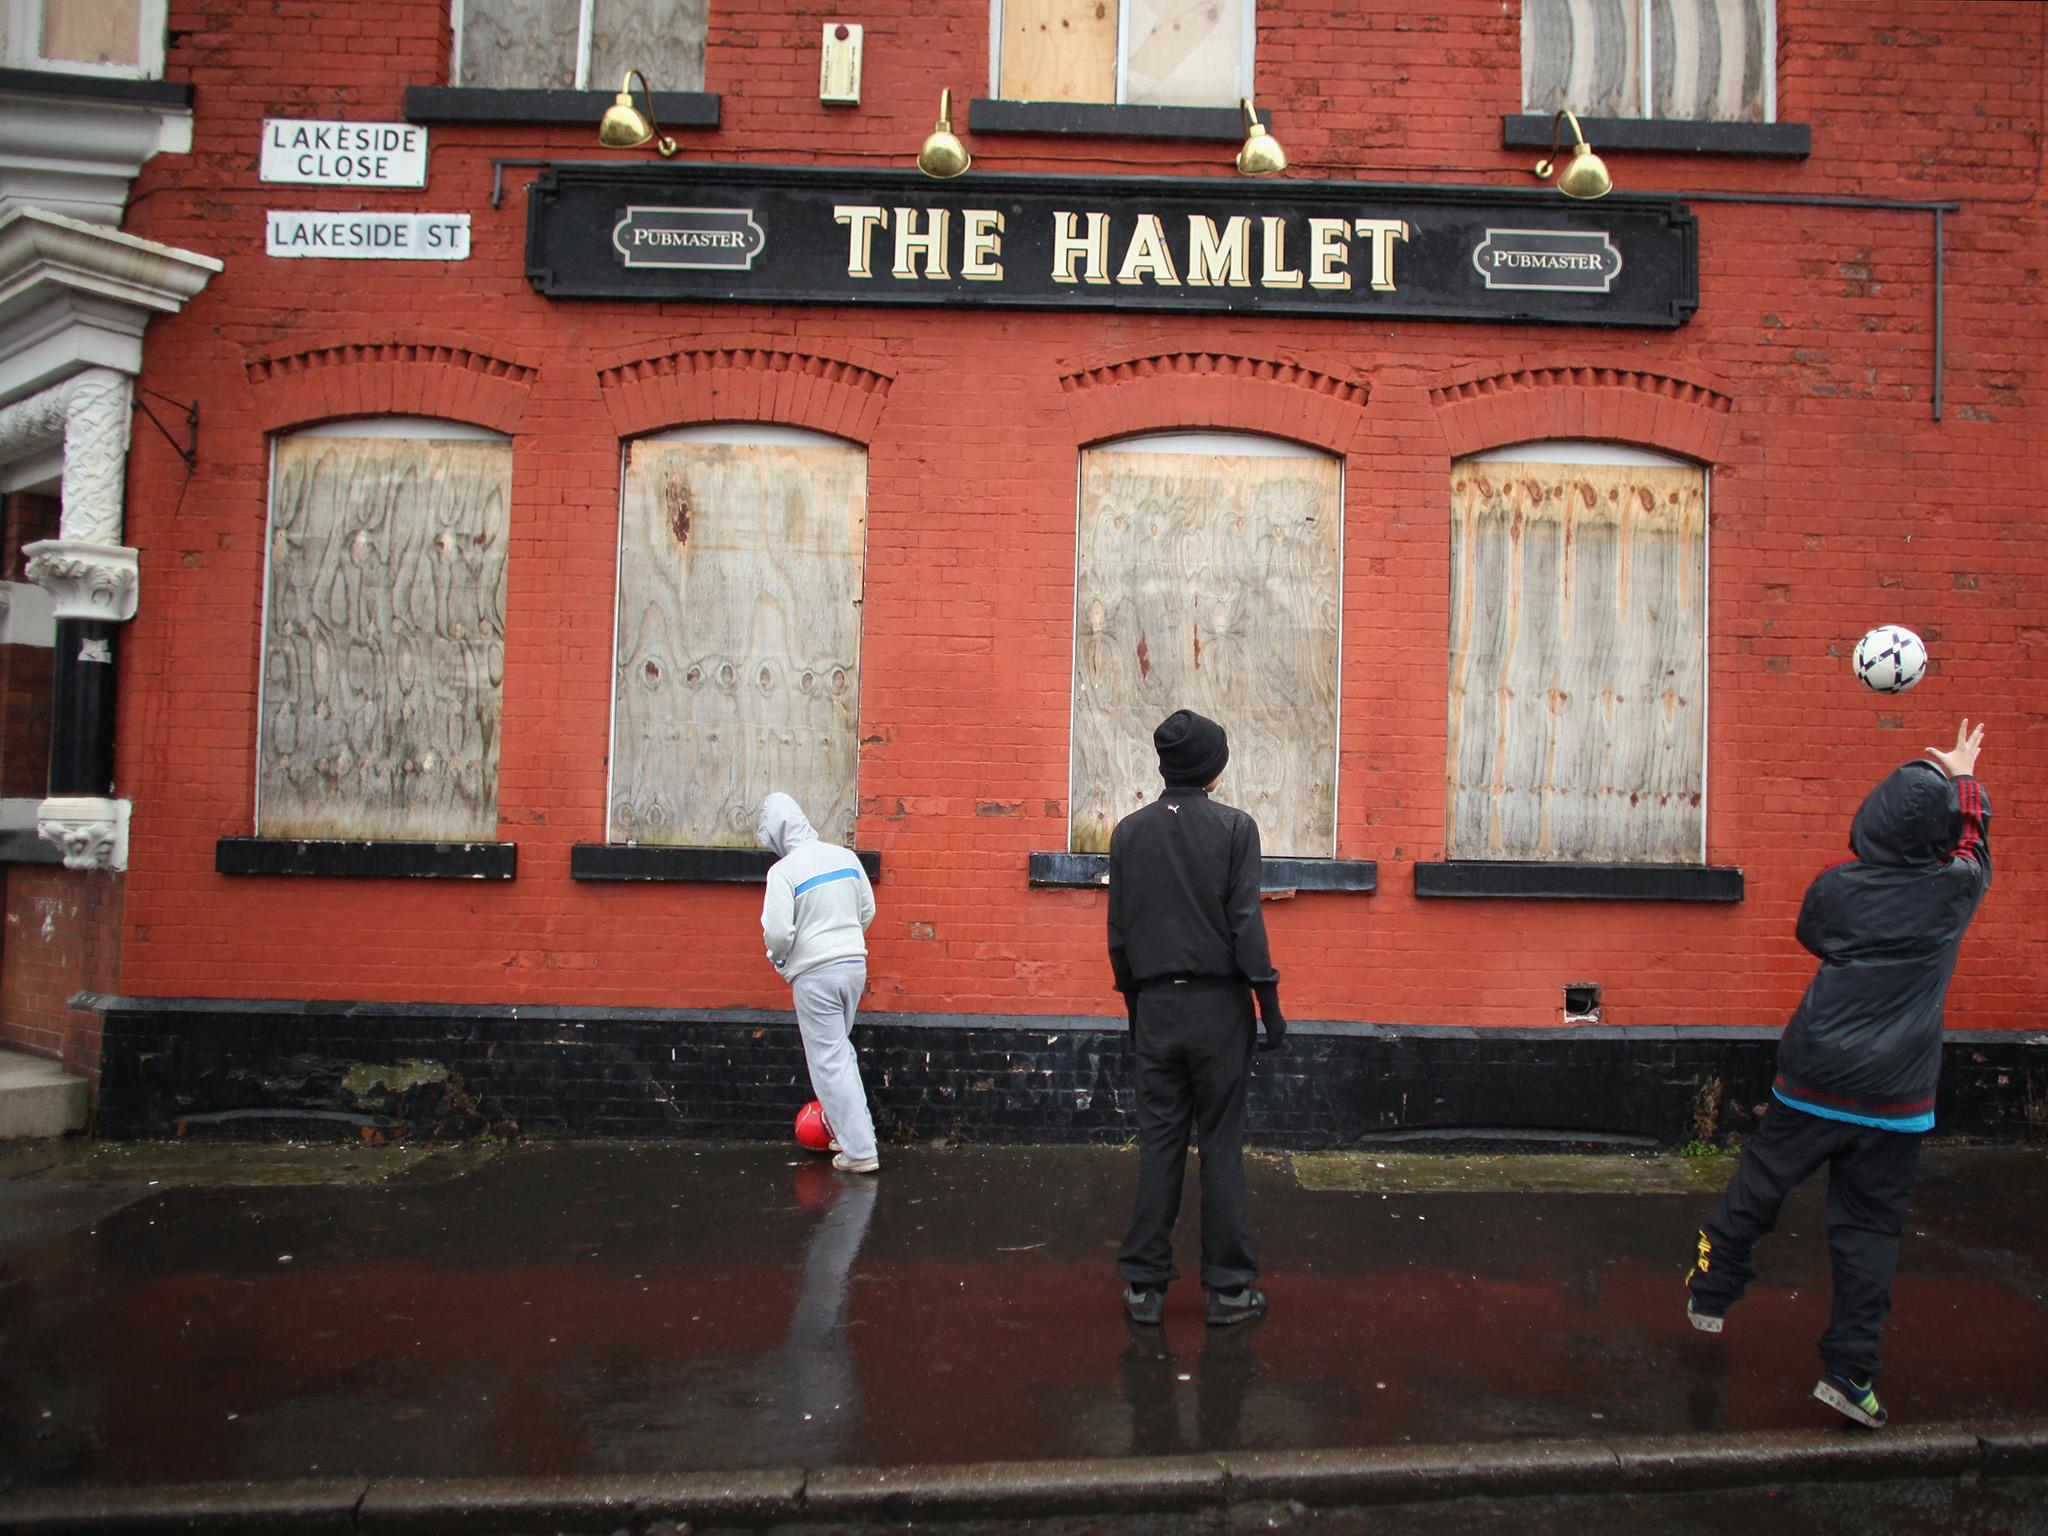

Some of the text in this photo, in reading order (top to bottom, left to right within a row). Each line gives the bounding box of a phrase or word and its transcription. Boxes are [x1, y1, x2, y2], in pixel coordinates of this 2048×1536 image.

[273, 125, 416, 152] LAKESIDE
[297, 154, 389, 179] CLOSE
[275, 223, 408, 247] LAKESIDE
[633, 228, 746, 248] PUBMASTER
[833, 205, 1410, 291] THE HAMLET
[1493, 250, 1603, 270] PUBMASTER
